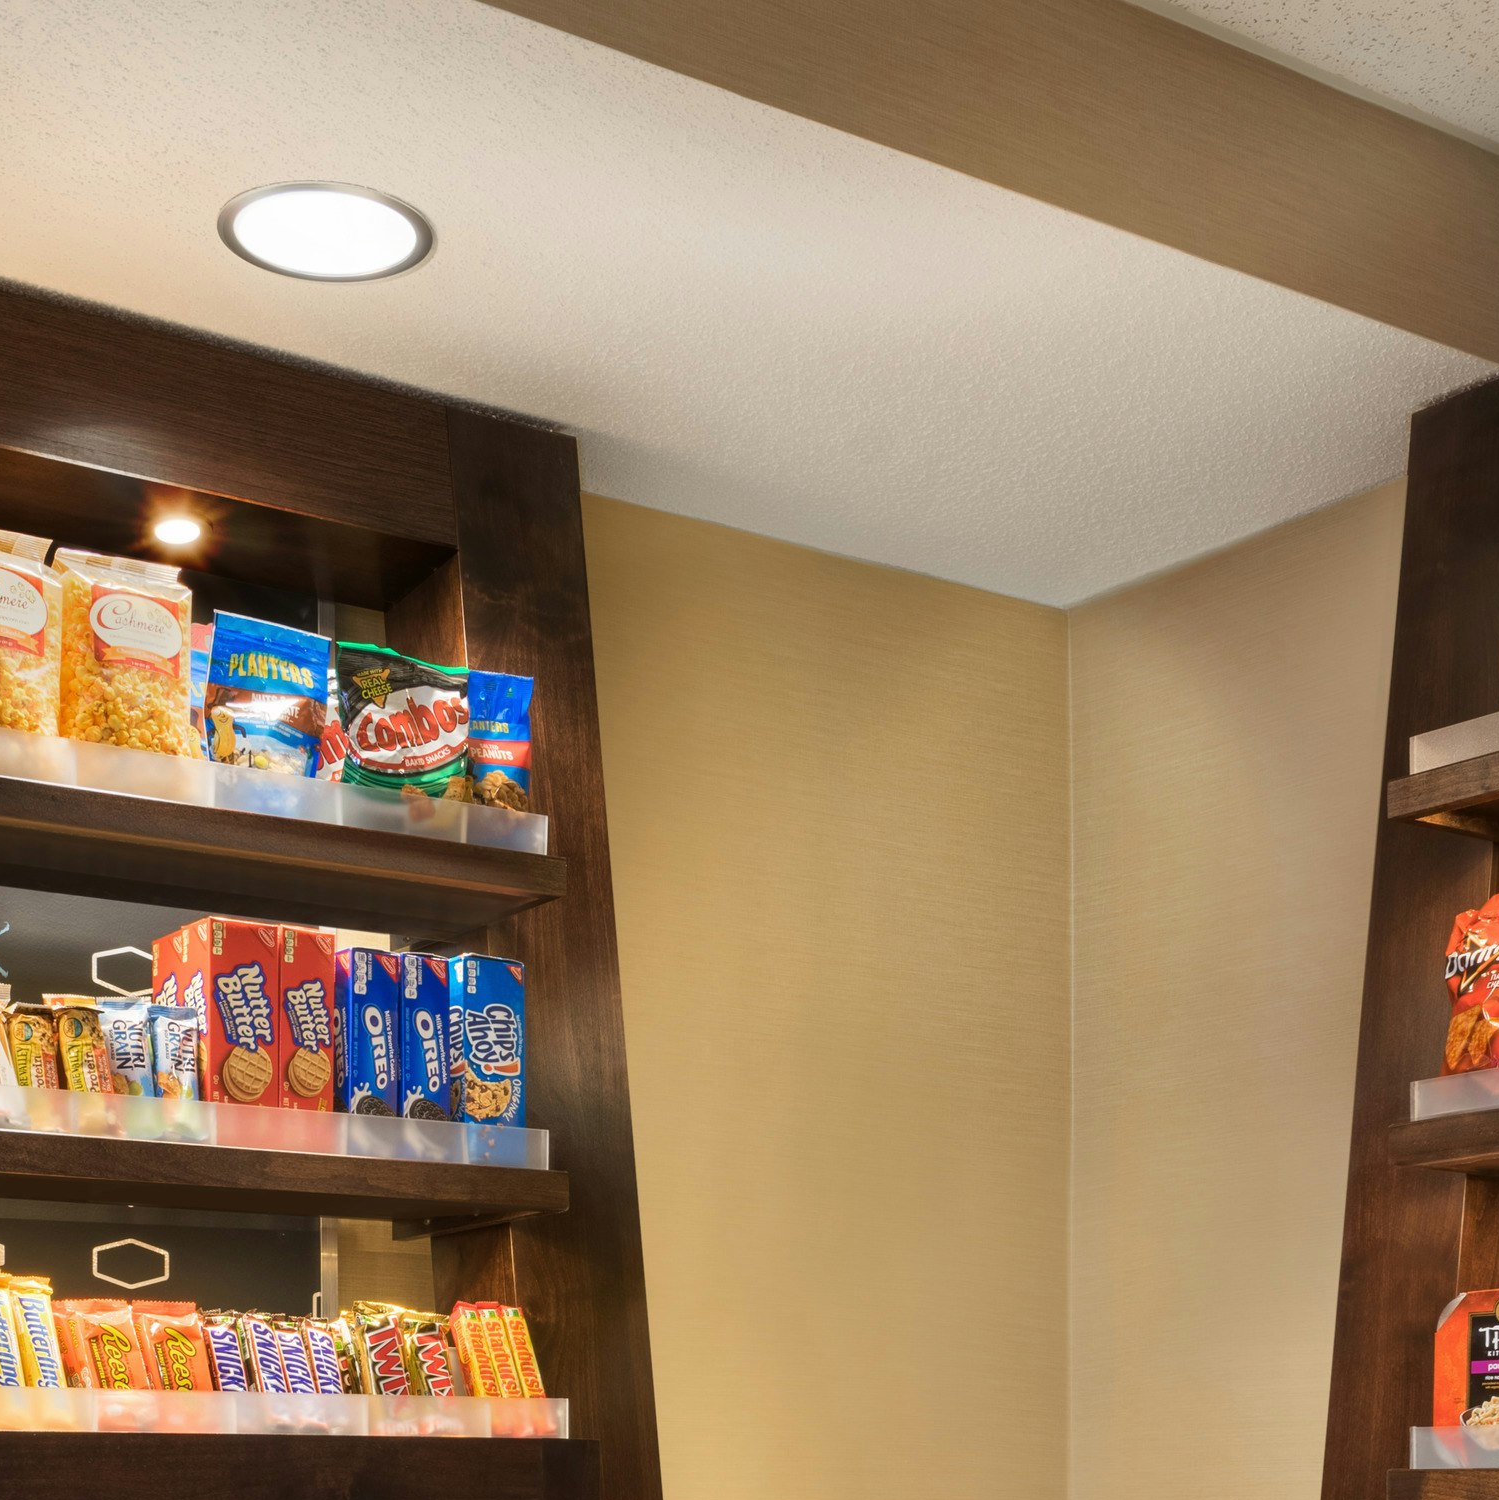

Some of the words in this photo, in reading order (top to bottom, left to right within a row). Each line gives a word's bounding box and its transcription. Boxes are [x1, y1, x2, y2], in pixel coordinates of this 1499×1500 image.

[96, 599, 166, 635] Cashmere
[229, 653, 314, 689] PLANTERS
[361, 675, 386, 690] REAL
[361, 683, 393, 700] CHEESE
[356, 697, 470, 753] Combos
[425, 746, 451, 765] SNACKS
[470, 746, 514, 762] PEANUTS
[218, 975, 256, 1049] Butter
[237, 965, 272, 1042] Nutter
[287, 990, 317, 1051] Butter
[303, 981, 330, 1045] Nutter
[113, 1020, 133, 1070] GRAIN
[364, 1006, 388, 1089] OREO
[416, 1010, 441, 1092] OREO
[484, 1004, 515, 1062] Chips
[505, 1079, 522, 1122] ORIGINAL
[508, 1320, 541, 1397] Starburst
